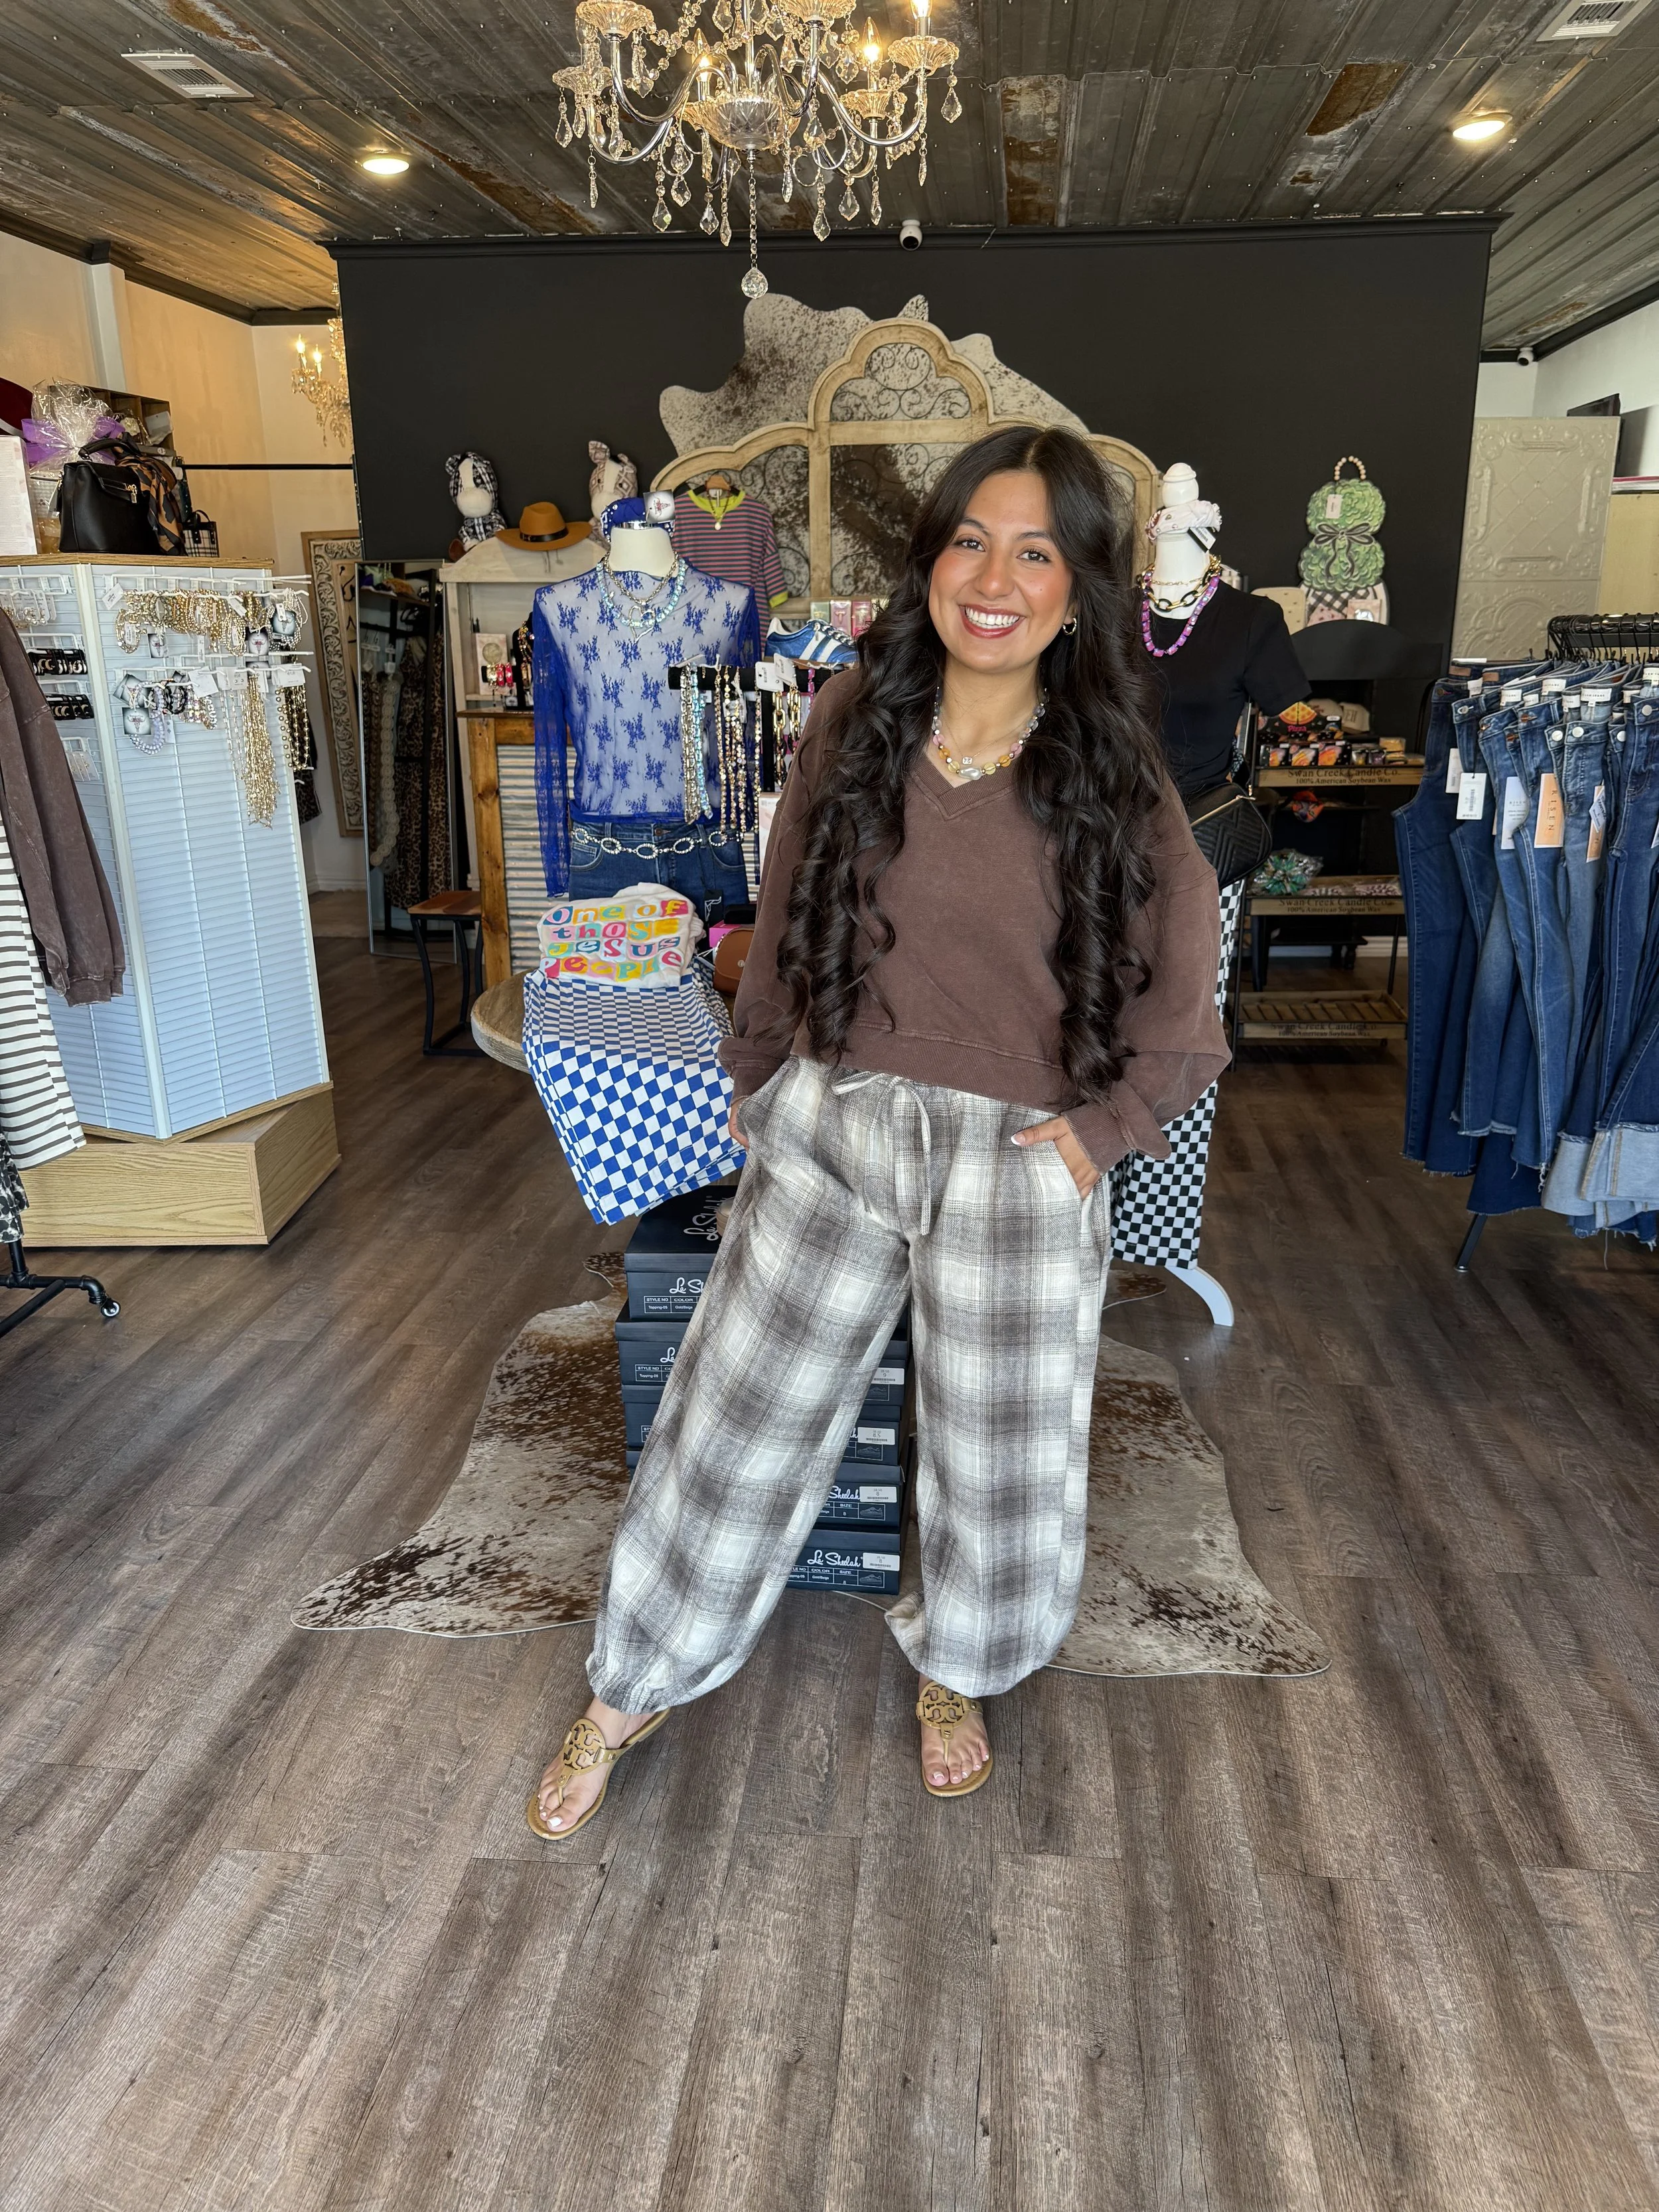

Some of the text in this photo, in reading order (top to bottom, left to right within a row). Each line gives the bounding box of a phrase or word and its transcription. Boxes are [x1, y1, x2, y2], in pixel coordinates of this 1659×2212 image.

[1347, 769, 1382, 777] Candle
[1548, 789, 1558, 832] RISEN
[1279, 898, 1305, 907] Swan
[1307, 898, 1334, 907] Creek
[1337, 898, 1372, 907] Candle
[825, 1552, 861, 1568] Sheelah
